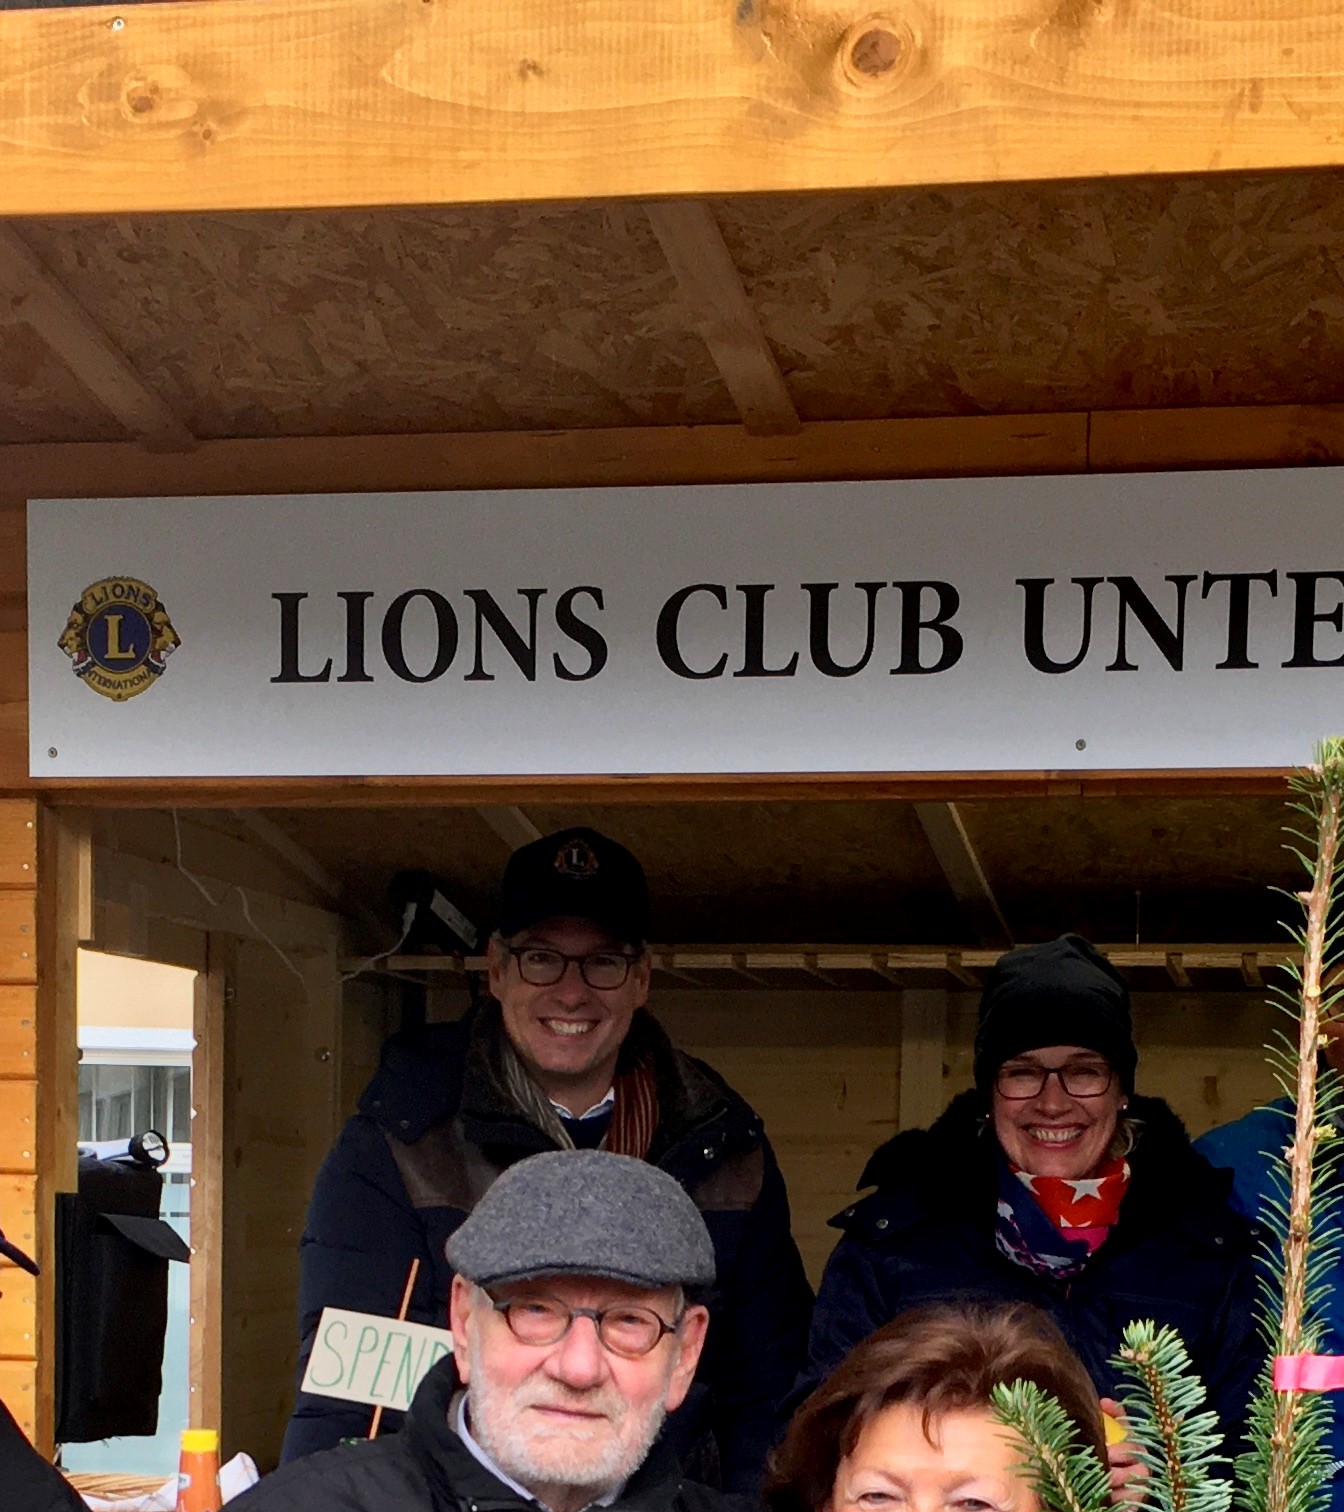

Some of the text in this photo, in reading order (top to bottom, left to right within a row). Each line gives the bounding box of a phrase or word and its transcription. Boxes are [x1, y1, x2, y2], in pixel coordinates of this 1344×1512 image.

[91, 583, 152, 607] LIONS
[104, 614, 136, 659] L
[269, 585, 609, 684] LIONS
[655, 580, 964, 680] CLUB
